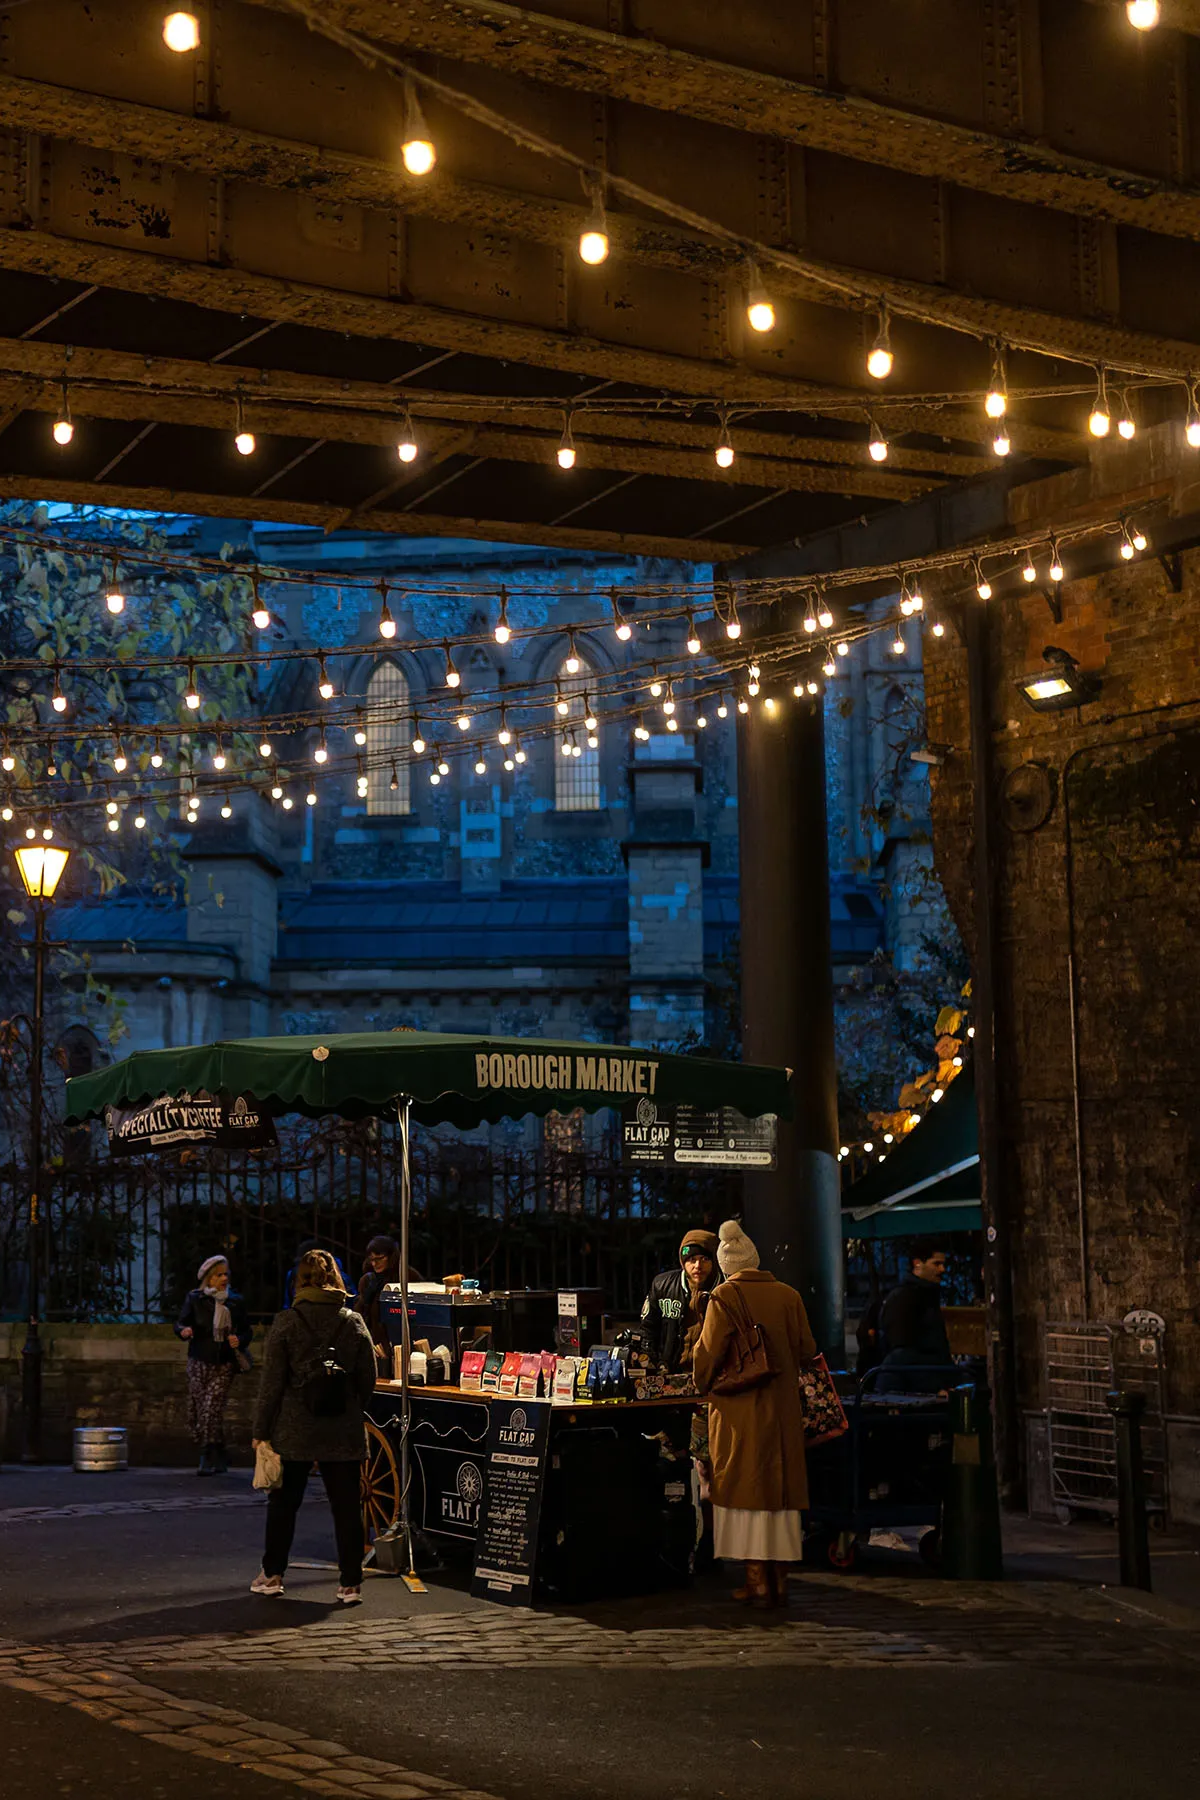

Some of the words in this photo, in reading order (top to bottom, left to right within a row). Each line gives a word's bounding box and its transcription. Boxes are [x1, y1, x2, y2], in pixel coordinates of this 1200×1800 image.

[475, 1053, 571, 1089] BOROUGH
[576, 1056, 659, 1095] MARKET
[119, 1104, 190, 1138] SPECIALITY
[229, 1115, 243, 1126] FLAT
[244, 1115, 260, 1127] CAP
[625, 1127, 648, 1141] FLAT
[651, 1127, 670, 1142] CAP
[499, 1430, 518, 1442] FLAT
[519, 1432, 535, 1444] CAP
[442, 1498, 471, 1521] FLAT
